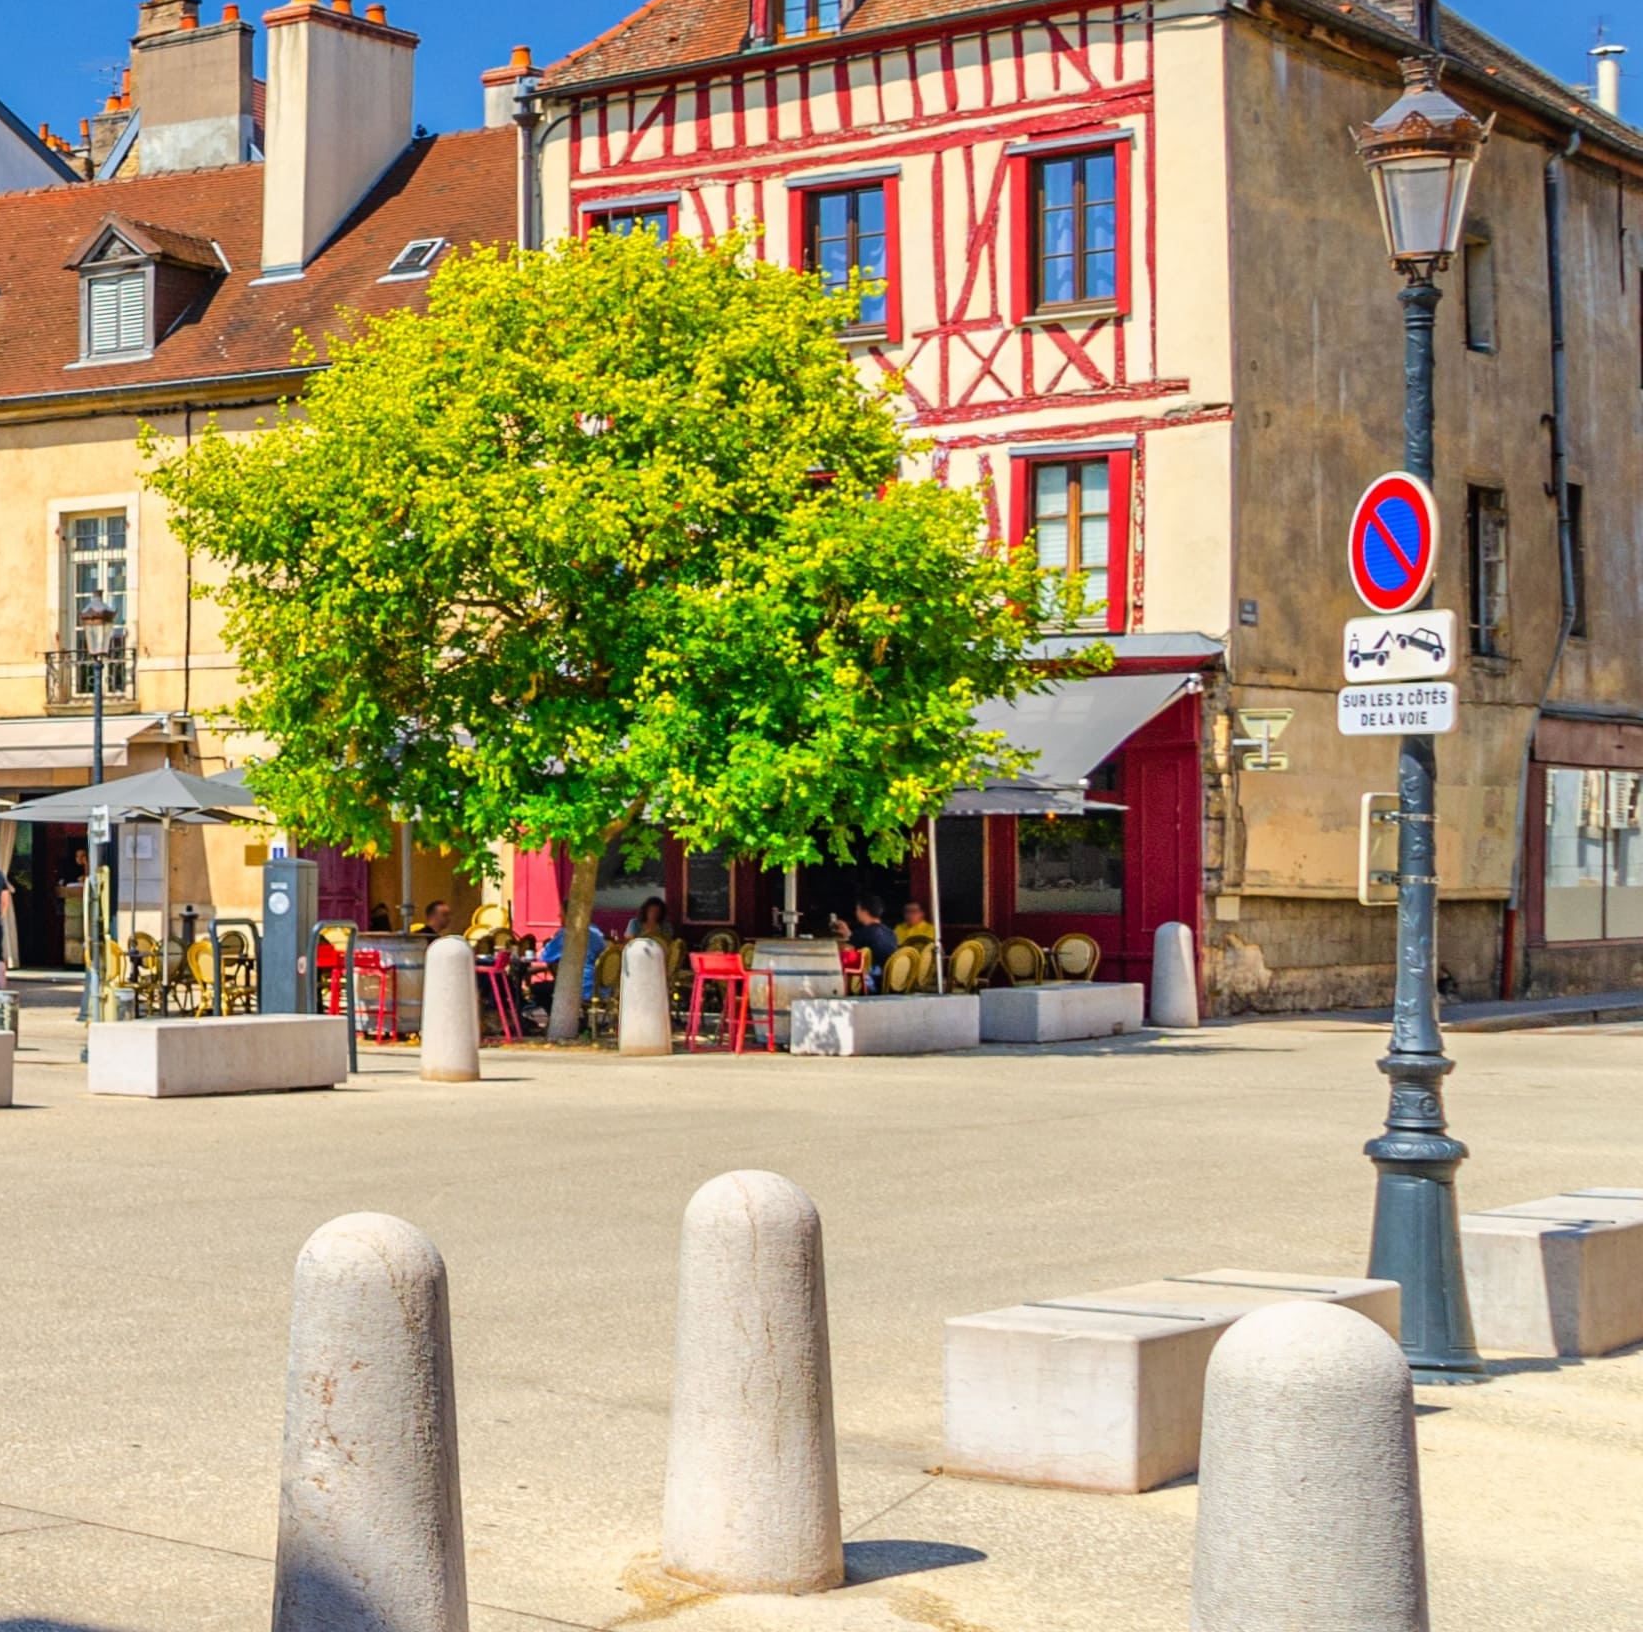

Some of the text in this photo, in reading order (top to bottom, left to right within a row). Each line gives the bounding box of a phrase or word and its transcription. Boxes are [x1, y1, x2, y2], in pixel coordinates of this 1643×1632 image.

[1343, 688, 1447, 708] SUR LES 2 CÔTÉS
[1361, 711, 1428, 726] DE LA VOIE
